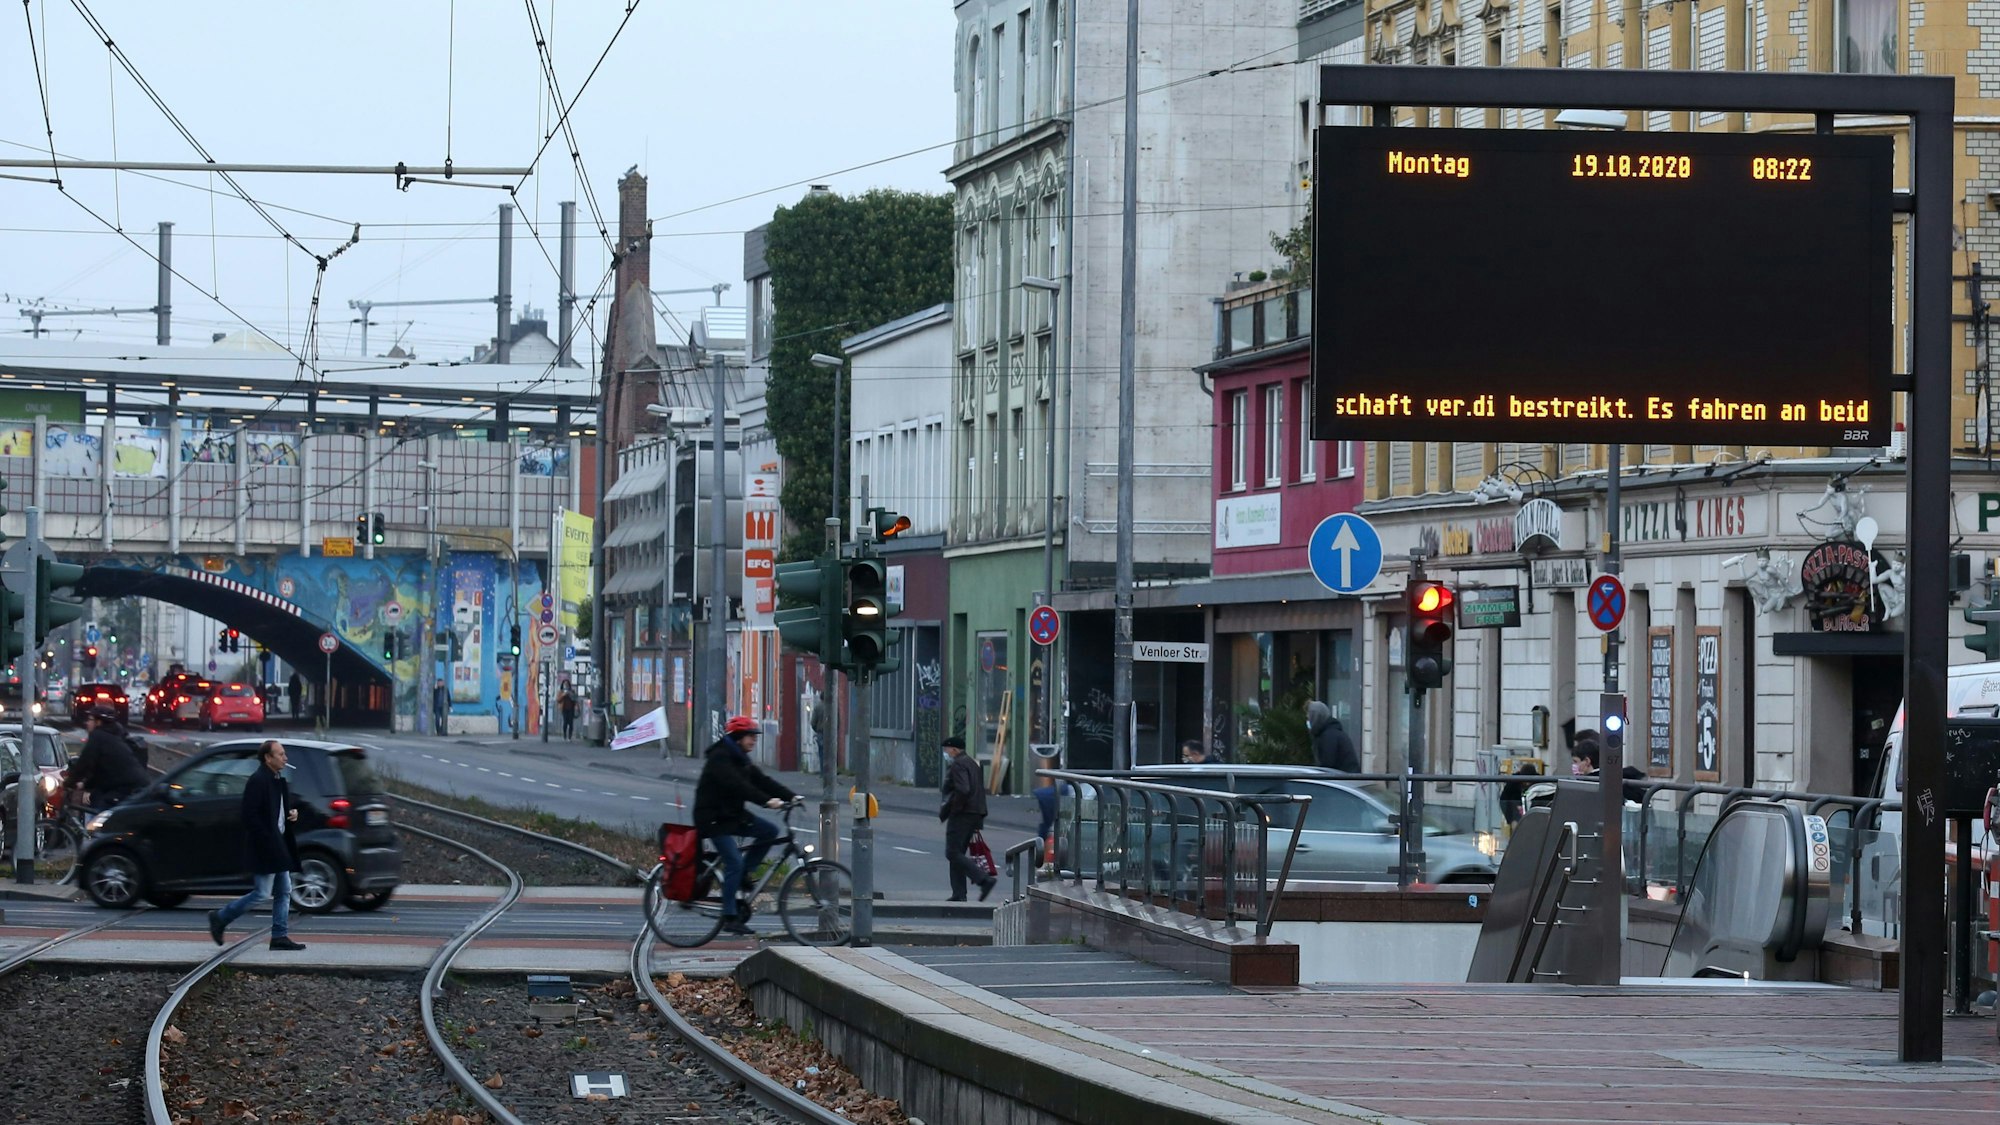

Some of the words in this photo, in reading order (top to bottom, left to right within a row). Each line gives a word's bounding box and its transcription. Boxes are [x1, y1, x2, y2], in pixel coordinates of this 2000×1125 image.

[1388, 151, 1470, 178] Montag
[1572, 154, 1691, 178] 19.10.2020
[1752, 157, 1811, 180] 08:22
[1336, 393, 1412, 416] schaft
[1426, 394, 1495, 417] ver.di
[1509, 395, 1633, 419] bestreikt.
[1647, 397, 1673, 419] Es
[1687, 397, 1766, 421] fahren
[1780, 403, 1806, 421] an
[1820, 399, 1869, 422] beid
[1843, 429, 1870, 441] BBR
[1624, 502, 1670, 543] PIZZA
[1696, 495, 1745, 537] KINGS
[1978, 492, 2000, 532] P
[746, 559, 772, 569] EFG
[1464, 601, 1515, 614] ZIMMER
[1475, 613, 1504, 625] FREI
[1823, 614, 1870, 632] BURGER
[1139, 645, 1180, 658] Venloer
[1183, 646, 1202, 659] Str.
[1607, 756, 1620, 765] 57
